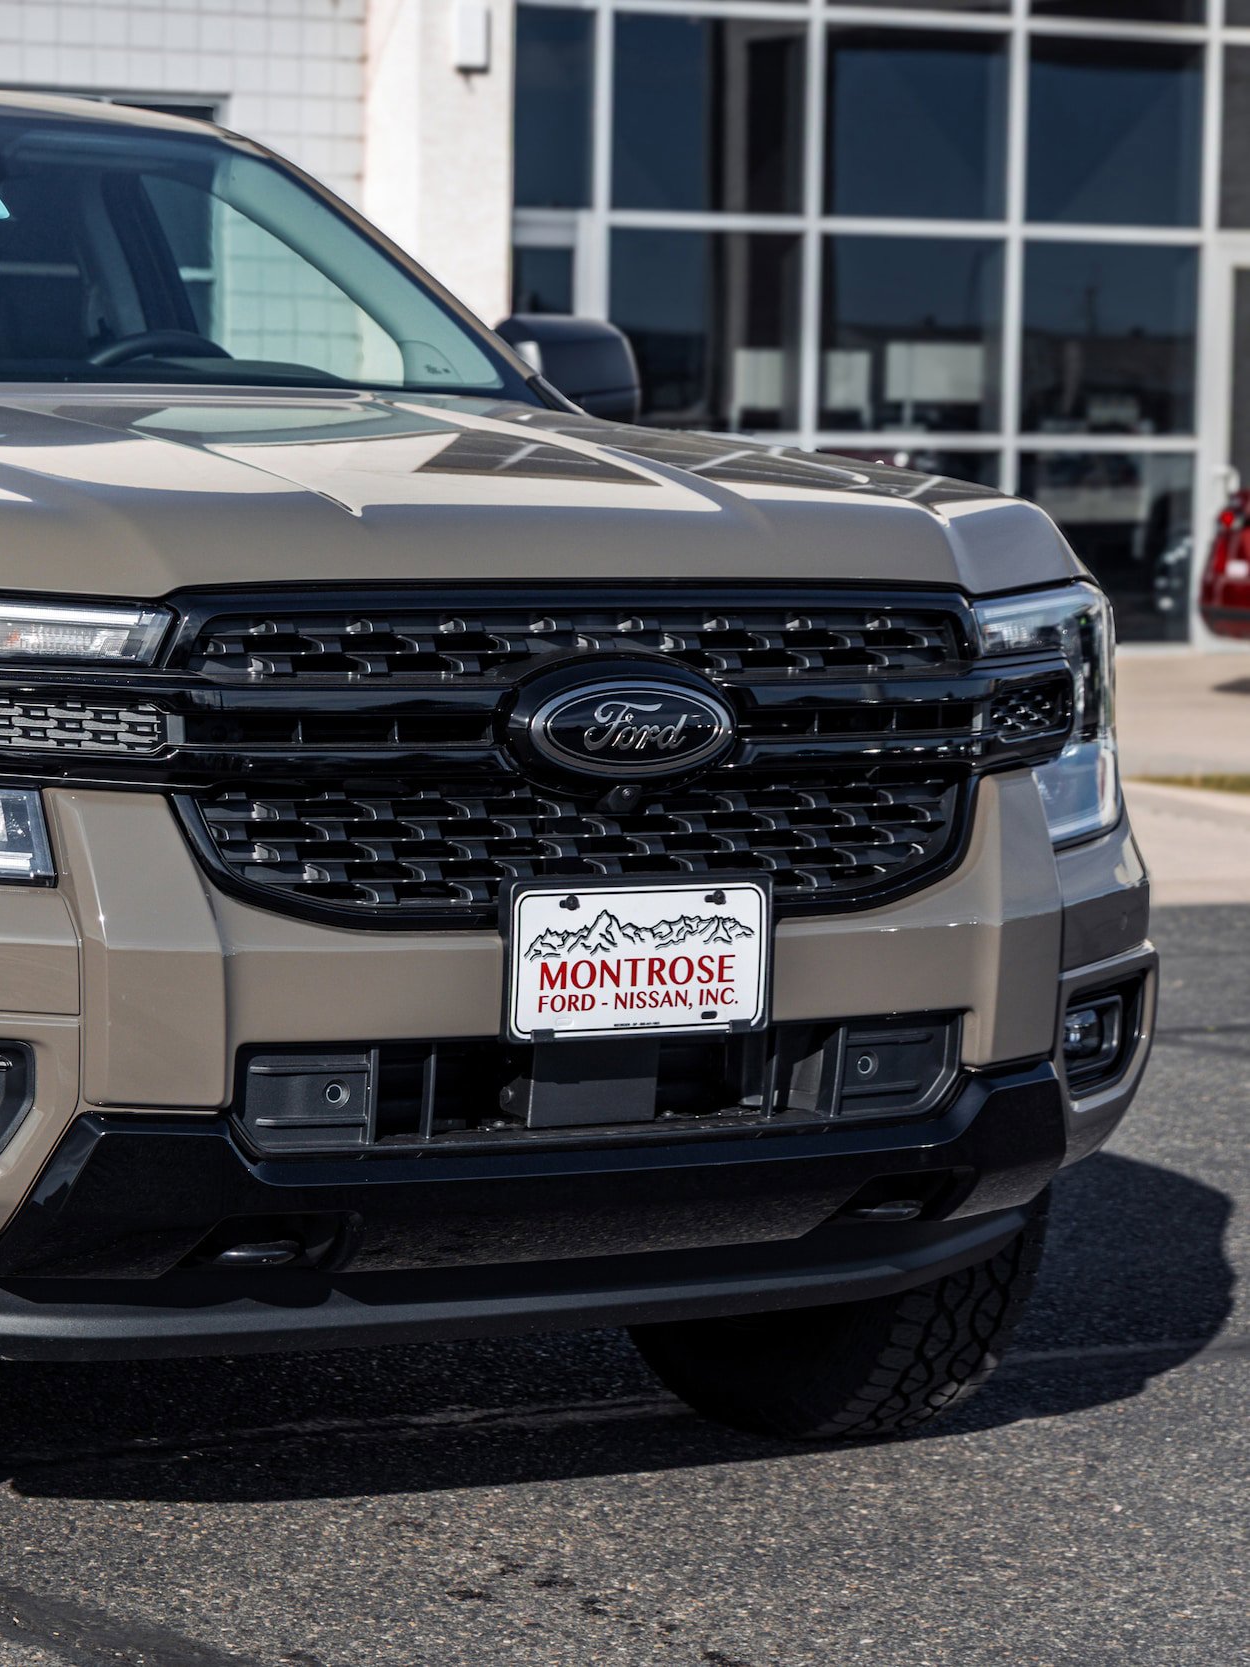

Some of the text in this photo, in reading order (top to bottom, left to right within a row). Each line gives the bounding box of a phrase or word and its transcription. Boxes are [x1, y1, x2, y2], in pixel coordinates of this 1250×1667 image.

[584, 700, 688, 751] Ford
[539, 954, 736, 991] MONTROSE
[537, 994, 597, 1013] FORD
[614, 990, 693, 1011] NISSAN,
[699, 987, 738, 1006] INC.
